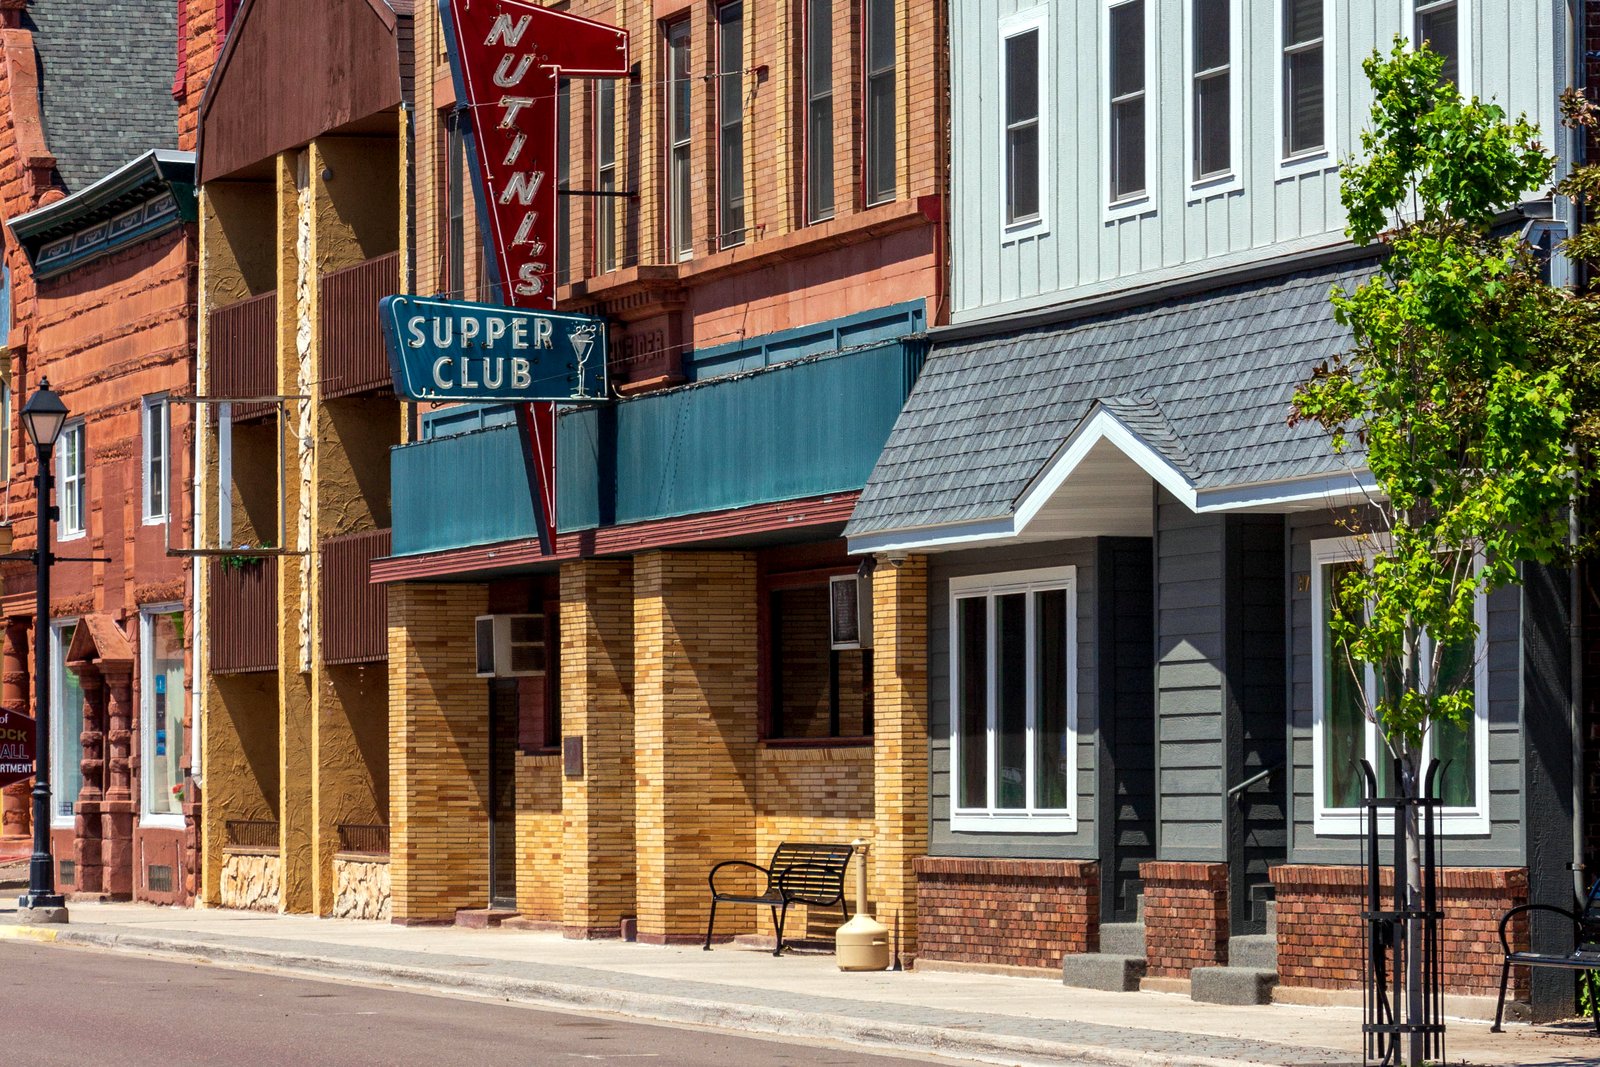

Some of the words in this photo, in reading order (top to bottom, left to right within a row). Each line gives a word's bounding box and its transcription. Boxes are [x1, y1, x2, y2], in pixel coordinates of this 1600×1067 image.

[484, 13, 546, 295] NUTINI'S
[407, 315, 554, 349] SUPPER
[610, 329, 665, 368] NEIDER
[433, 356, 532, 390] CLUB
